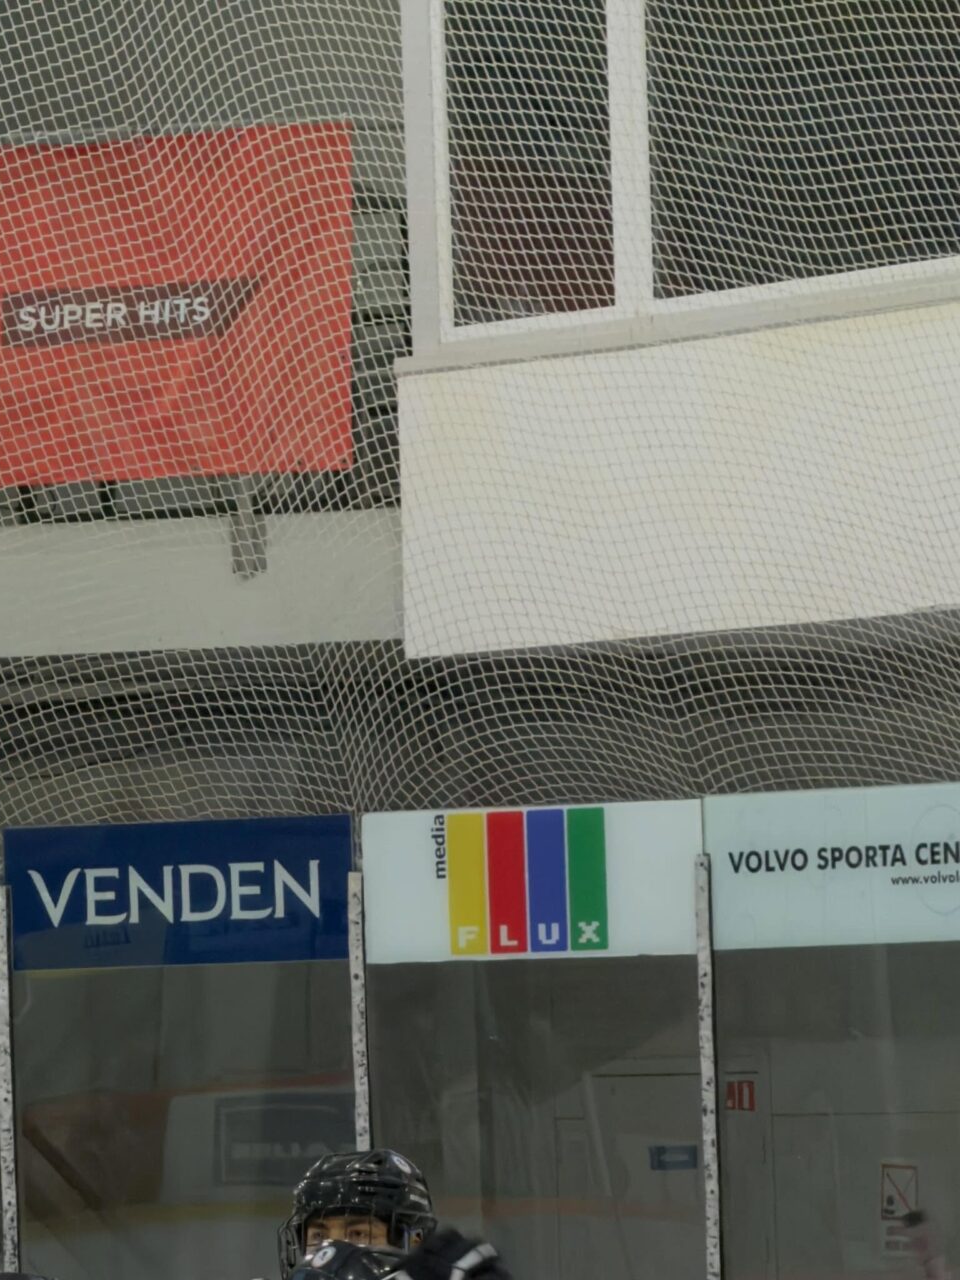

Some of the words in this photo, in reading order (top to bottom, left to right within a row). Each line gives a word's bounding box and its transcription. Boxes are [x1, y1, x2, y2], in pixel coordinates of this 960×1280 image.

[18, 301, 126, 333] SUPER
[138, 297, 211, 325] HITS
[431, 814, 446, 880] media
[728, 848, 808, 873] VOLVO
[817, 844, 907, 870] SPORTA
[28, 859, 320, 928] VENDEN
